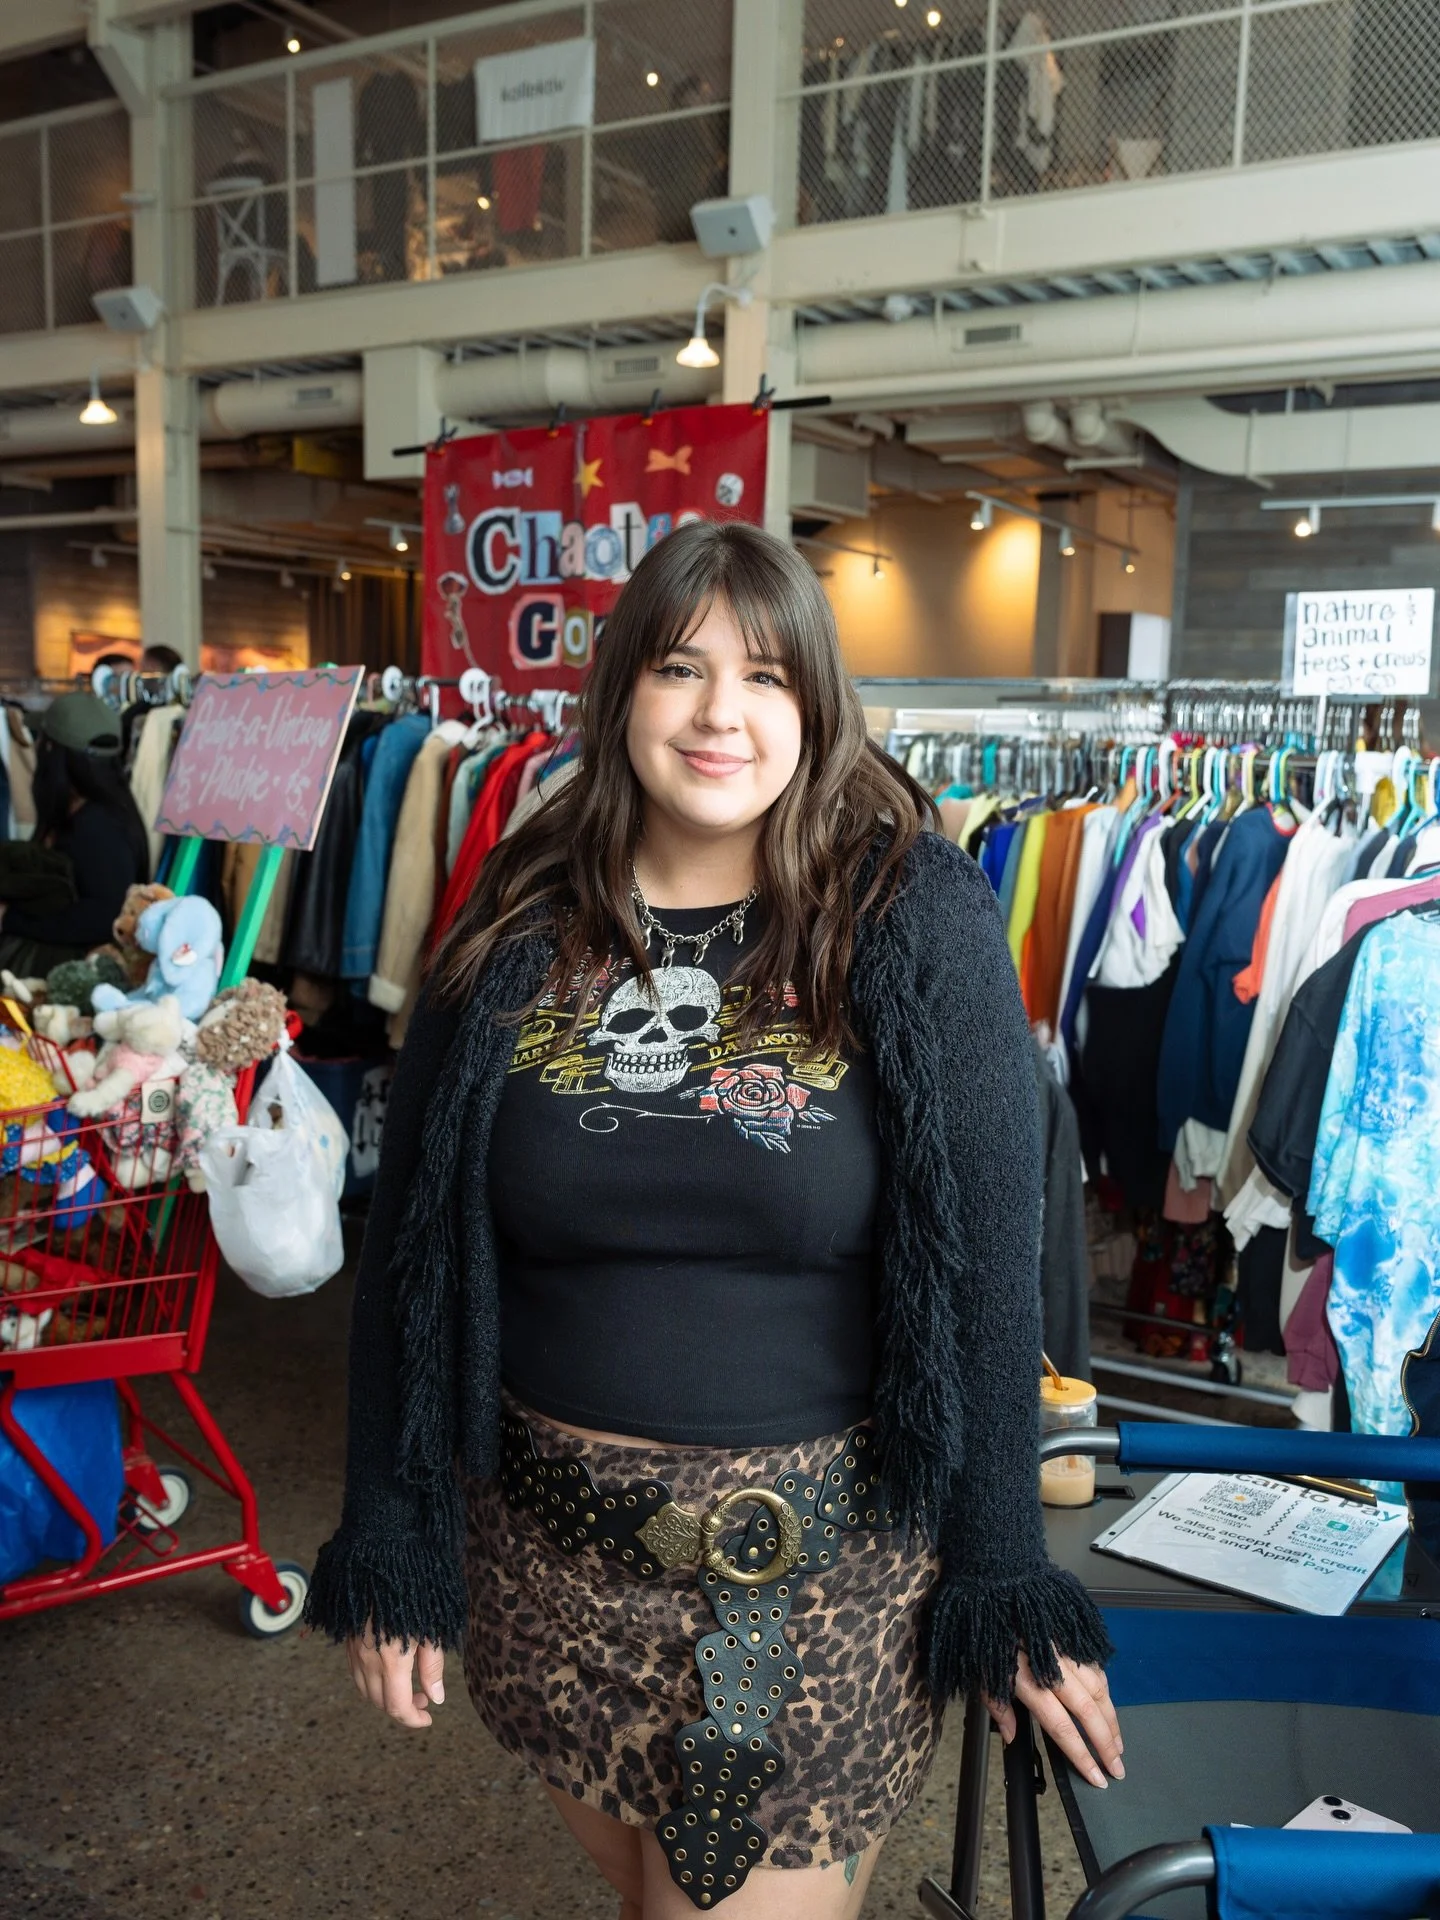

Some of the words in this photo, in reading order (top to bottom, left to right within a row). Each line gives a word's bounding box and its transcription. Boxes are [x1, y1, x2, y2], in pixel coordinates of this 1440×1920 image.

[1303, 599, 1395, 625] nature
[1303, 624, 1392, 648] animal
[1301, 653, 1350, 676] tees
[1373, 652, 1426, 669] crews
[1228, 1474, 1290, 1493] can
[1299, 1487, 1330, 1503] to
[1203, 1505, 1248, 1521] VENMO
[1158, 1510, 1181, 1522] We
[1183, 1519, 1216, 1532] also
[1218, 1530, 1272, 1548] accept
[1274, 1545, 1316, 1561] cash,
[1320, 1557, 1368, 1575] credit
[1173, 1525, 1216, 1541] cards
[1219, 1538, 1251, 1550] and
[1252, 1547, 1300, 1564] Apple
[1303, 1561, 1335, 1575] Pay
[1291, 1530, 1328, 1544] CASH
[1330, 1540, 1358, 1550] APP
